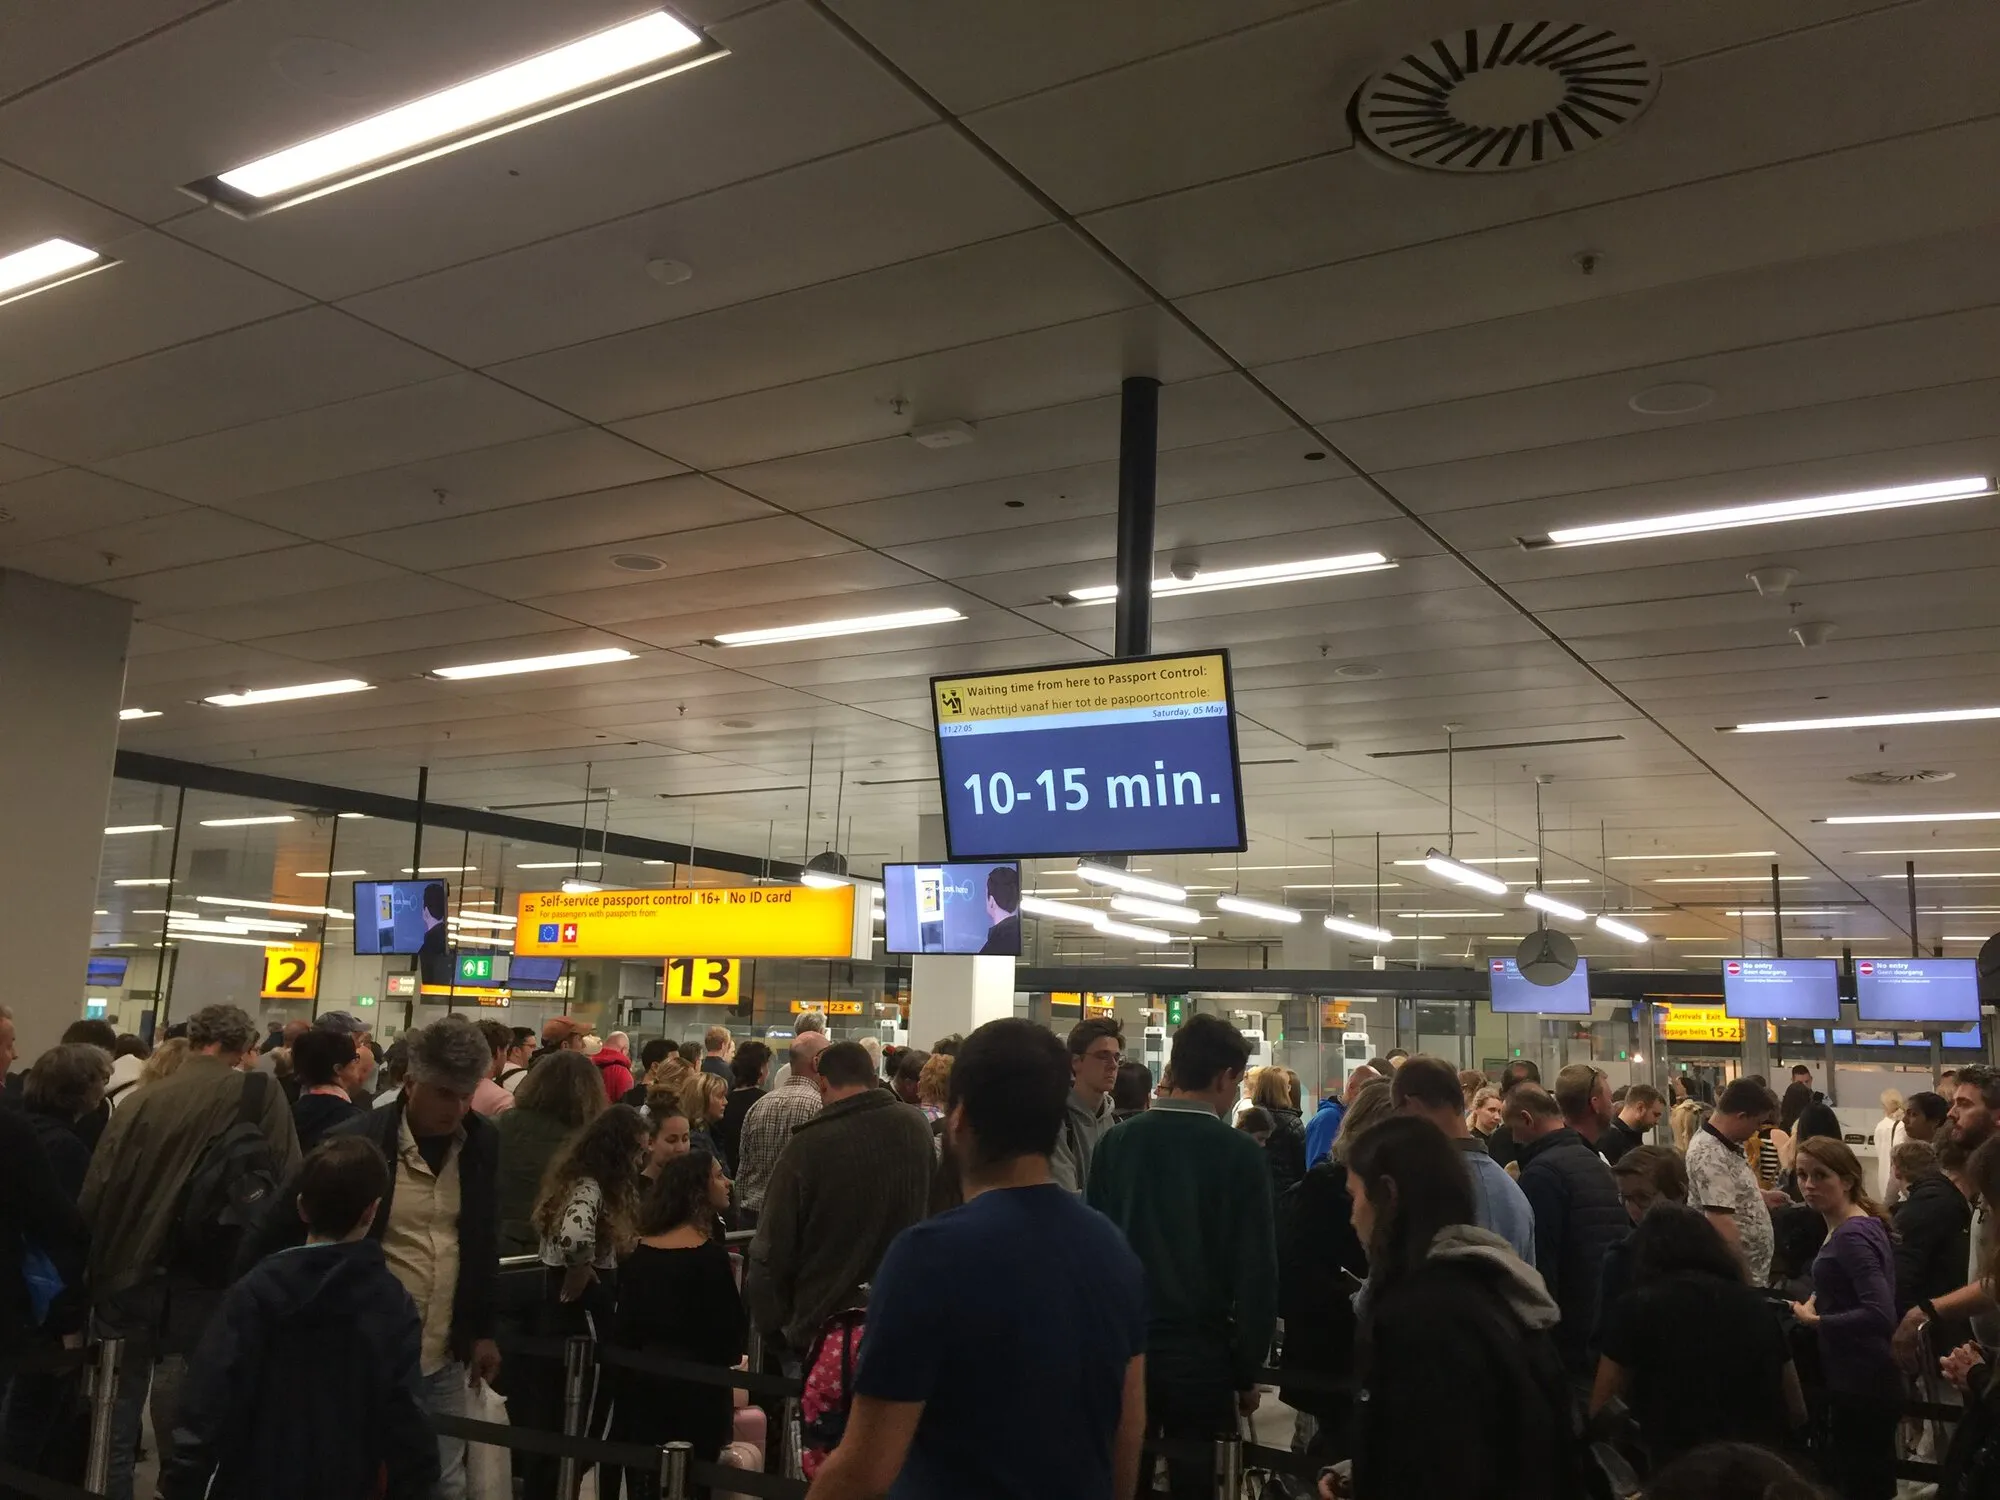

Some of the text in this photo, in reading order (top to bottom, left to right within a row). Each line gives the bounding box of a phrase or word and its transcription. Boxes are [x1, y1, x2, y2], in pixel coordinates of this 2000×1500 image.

[967, 666, 1208, 697] Waiting time from here to Passport Control:
[969, 687, 1210, 716] Wachttijd vanaf hier tot de paspoortcontrole:
[1152, 705, 1224, 718] Saturday, 05 May
[964, 760, 1221, 815] 10-15 min.
[540, 890, 792, 908] Self-service passport control 16+ No ID card
[551, 911, 587, 919] passengers
[605, 910, 637, 919] passports
[1754, 962, 1773, 970] entry
[1889, 962, 1909, 970] entry
[670, 958, 730, 998] 13
[1690, 1027, 1708, 1035] belts
